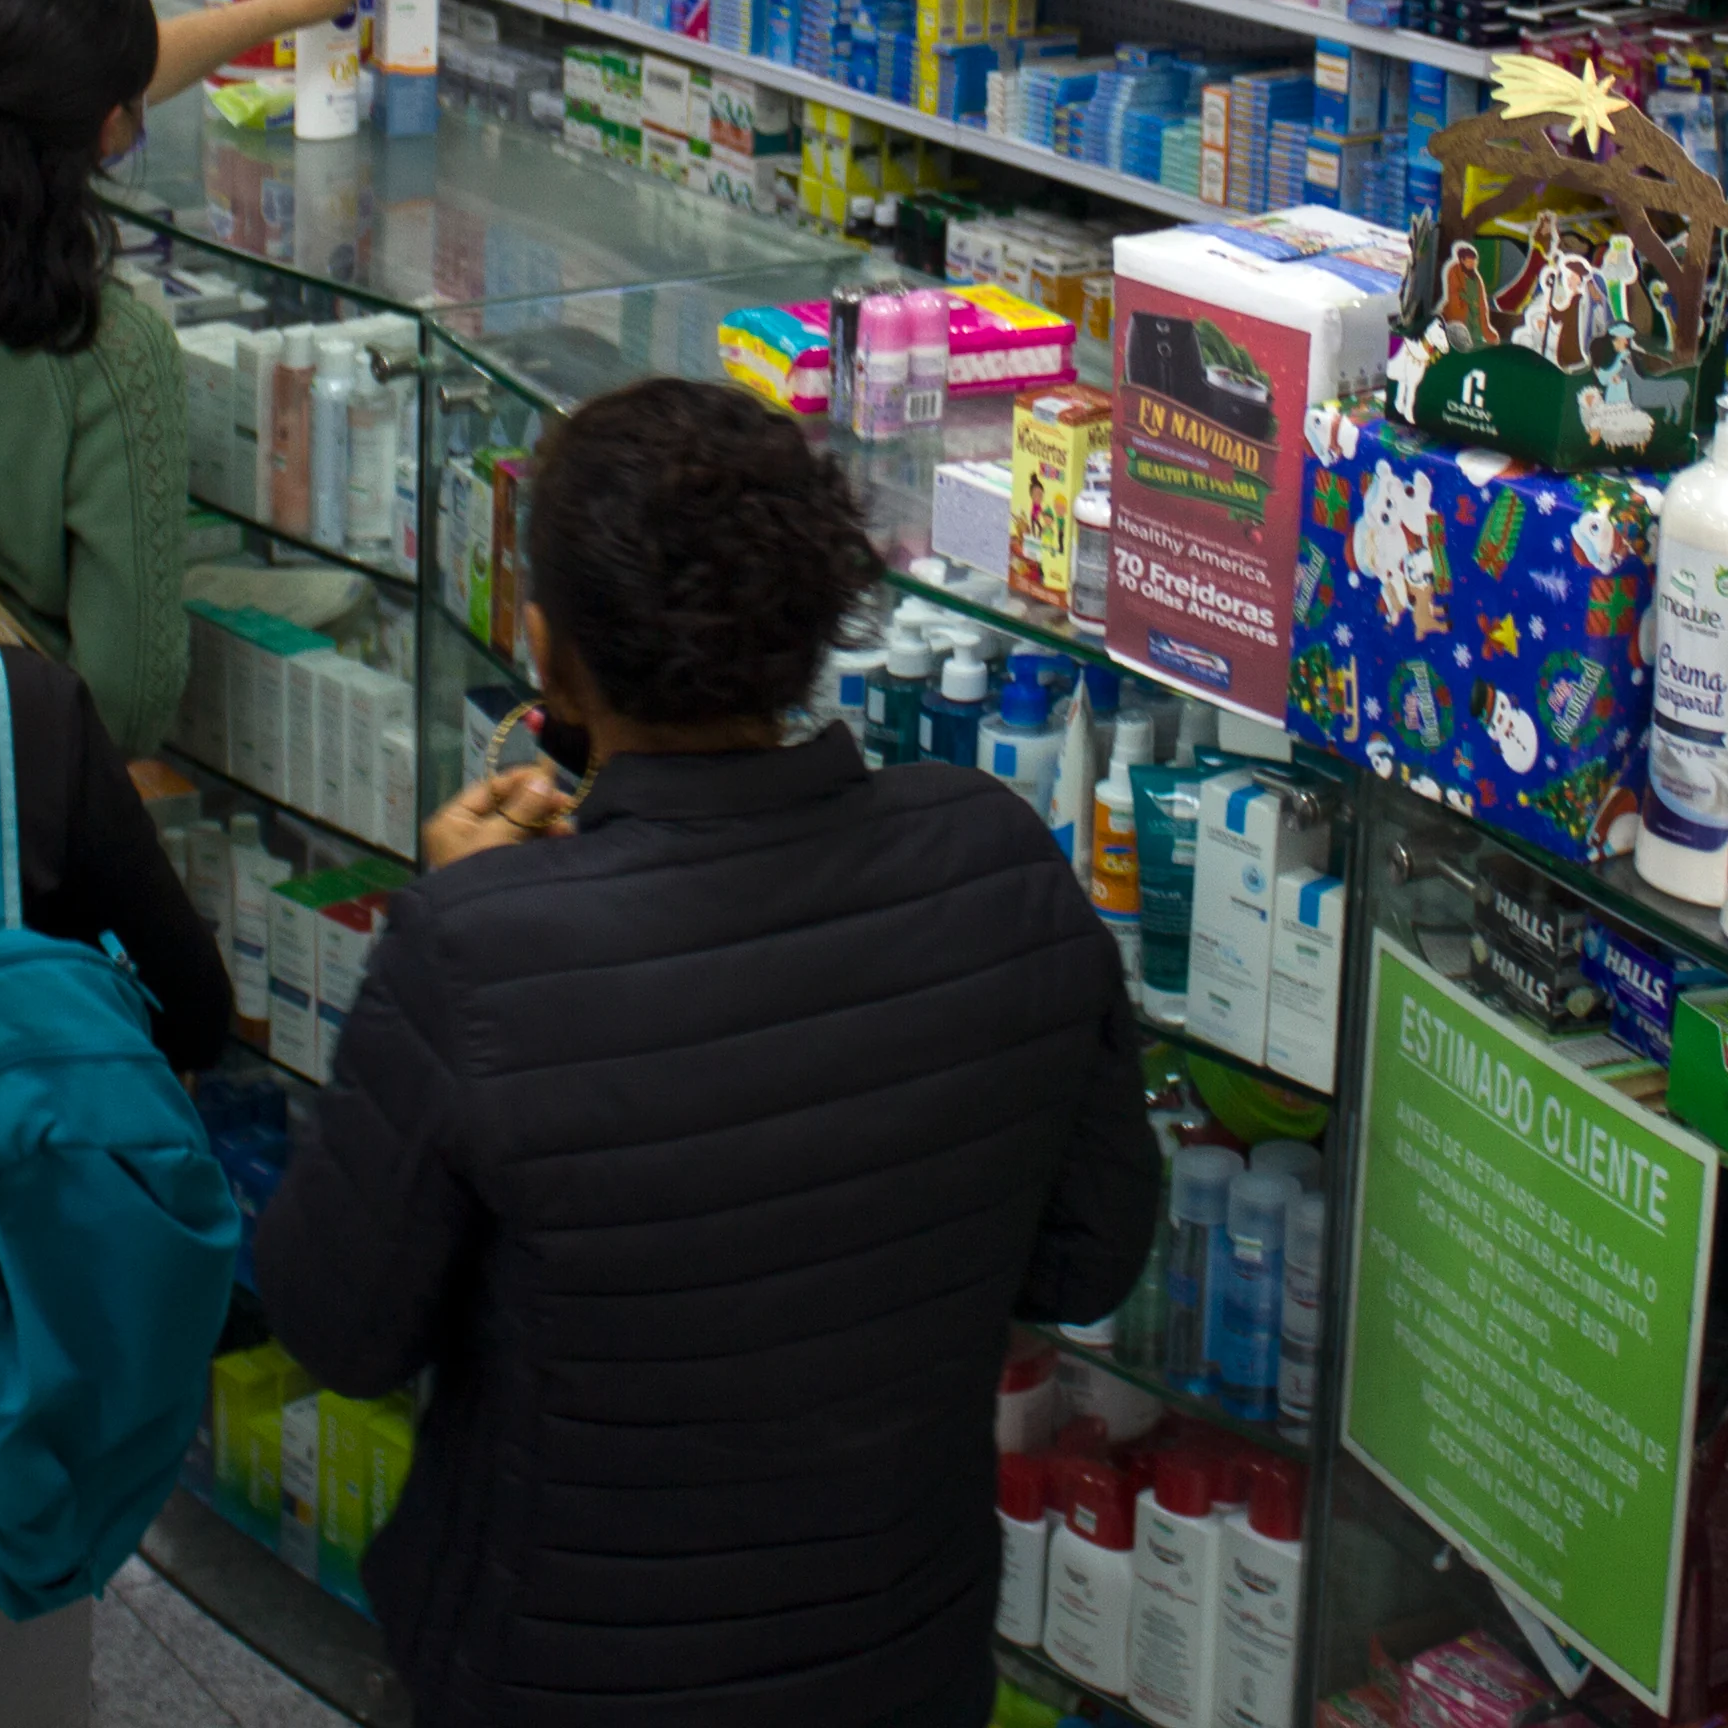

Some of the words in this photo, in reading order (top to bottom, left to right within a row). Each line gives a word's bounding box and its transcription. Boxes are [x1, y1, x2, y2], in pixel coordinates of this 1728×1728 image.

[1138, 395, 1166, 437] EN
[1171, 411, 1260, 472] NAVIDAD
[1114, 546, 1144, 576] 70
[1148, 560, 1275, 629] Freidoras
[1116, 512, 1184, 557] Healthy
[1187, 542, 1272, 589] America,
[1116, 569, 1138, 593] 70
[1140, 580, 1184, 612] Ollas
[1186, 600, 1279, 648] Arroceras
[1659, 643, 1728, 694] Crema
[1496, 890, 1556, 952] HALLS
[1491, 951, 1551, 1011] HALLS
[1604, 945, 1668, 1009] HALLS
[1398, 994, 1534, 1136] ESTIMADO
[1542, 1094, 1669, 1226] CLIENTE
